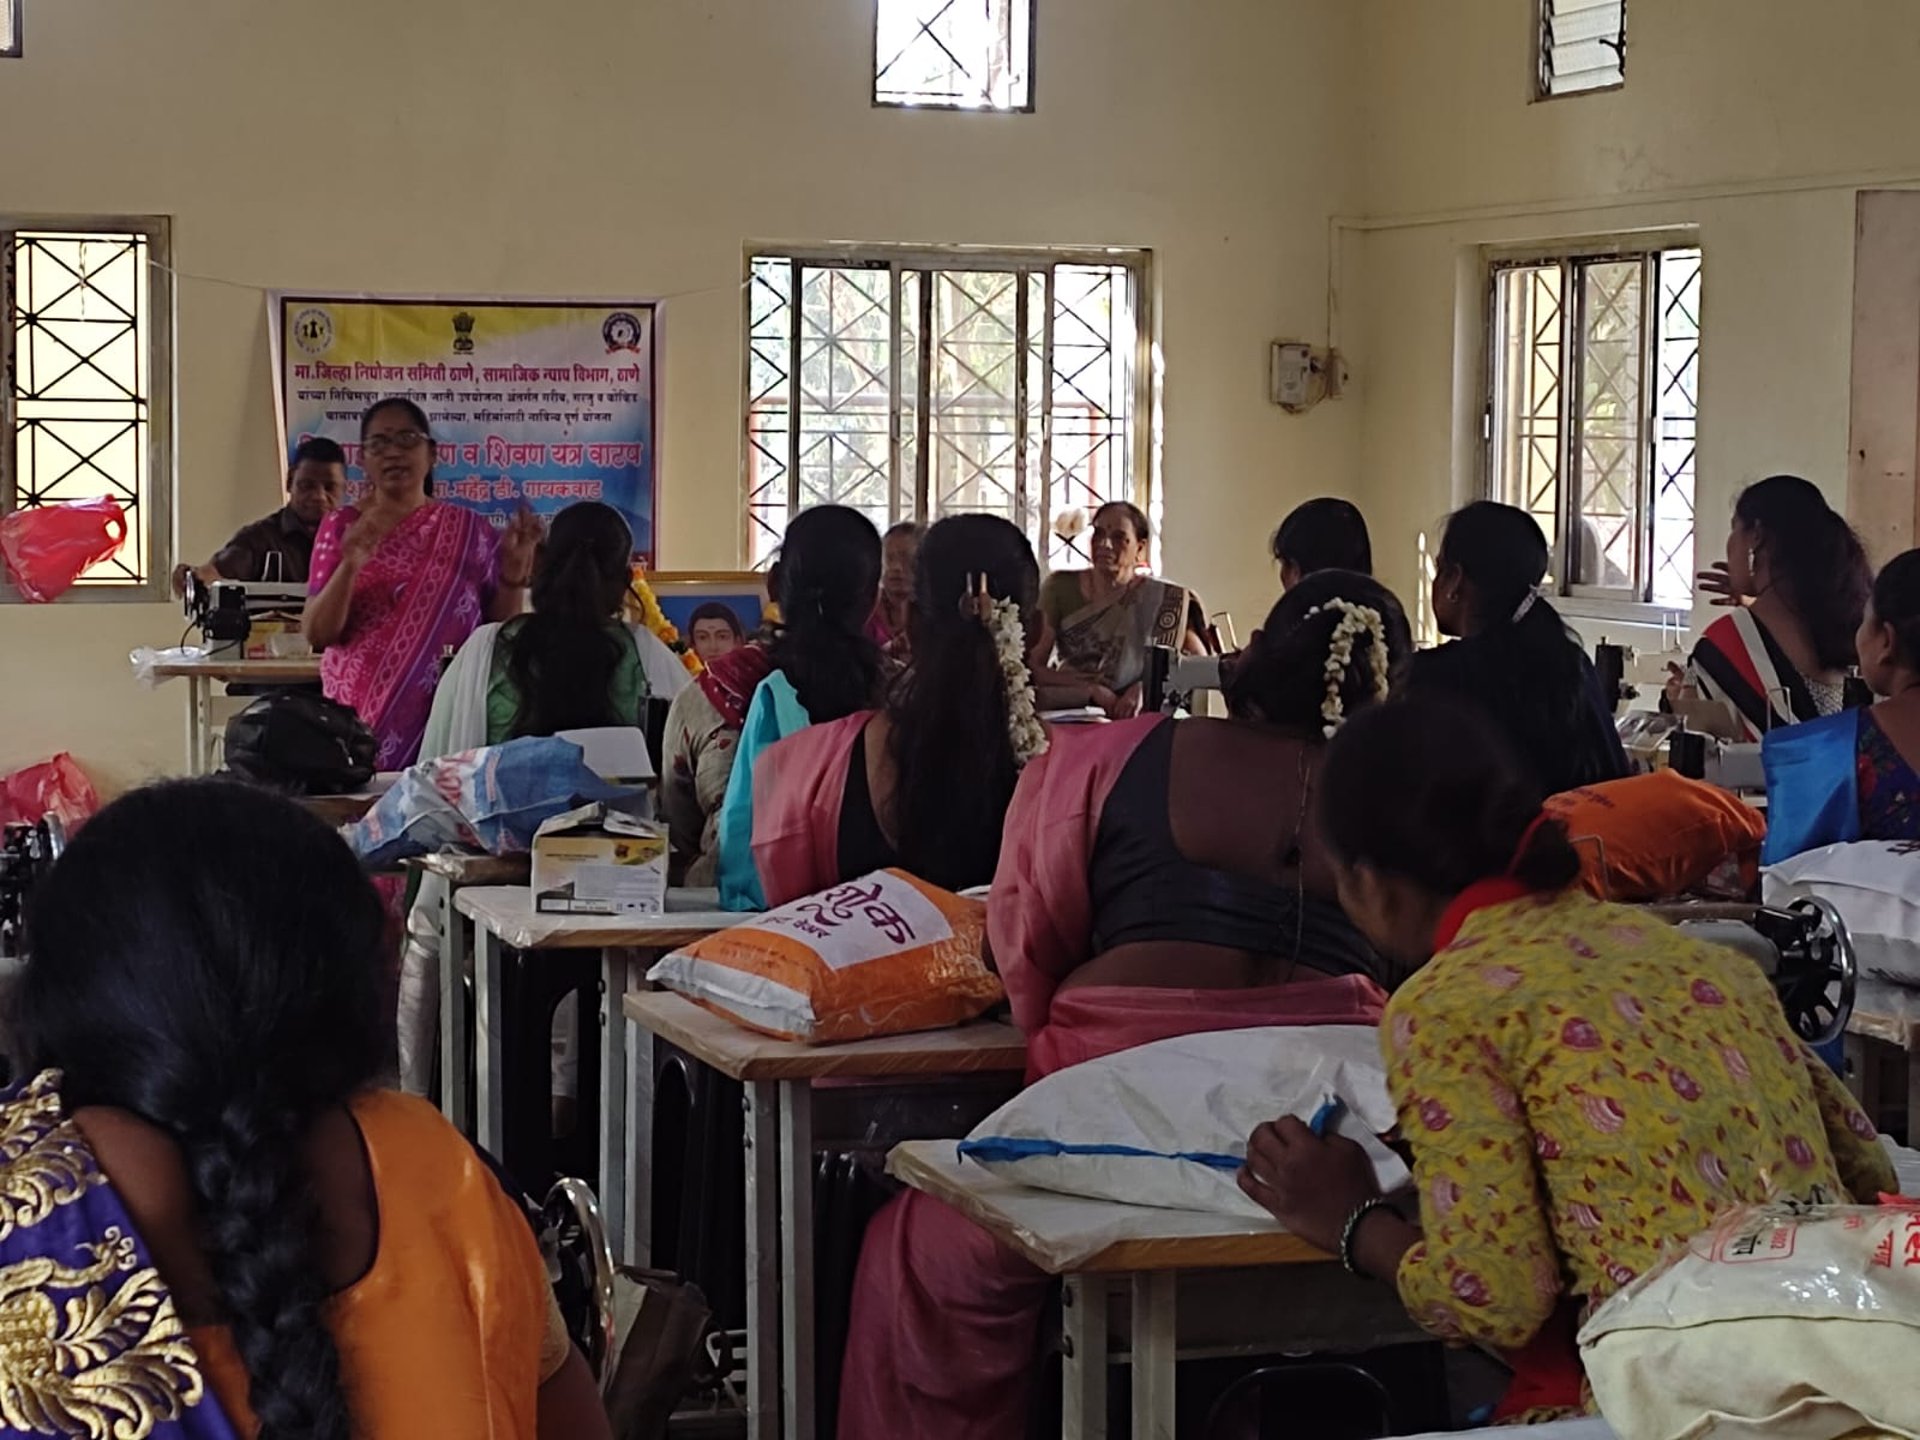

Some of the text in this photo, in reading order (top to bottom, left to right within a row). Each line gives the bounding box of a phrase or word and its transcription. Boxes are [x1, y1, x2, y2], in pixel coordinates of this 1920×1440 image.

[407, 362, 446, 382] समिती
[482, 363, 540, 383] सामाजिक
[617, 363, 640, 383] ठाणे
[464, 444, 480, 464] व
[486, 435, 544, 467] शिवण
[588, 443, 641, 466] वाटप
[524, 480, 602, 498] गायकवाड
